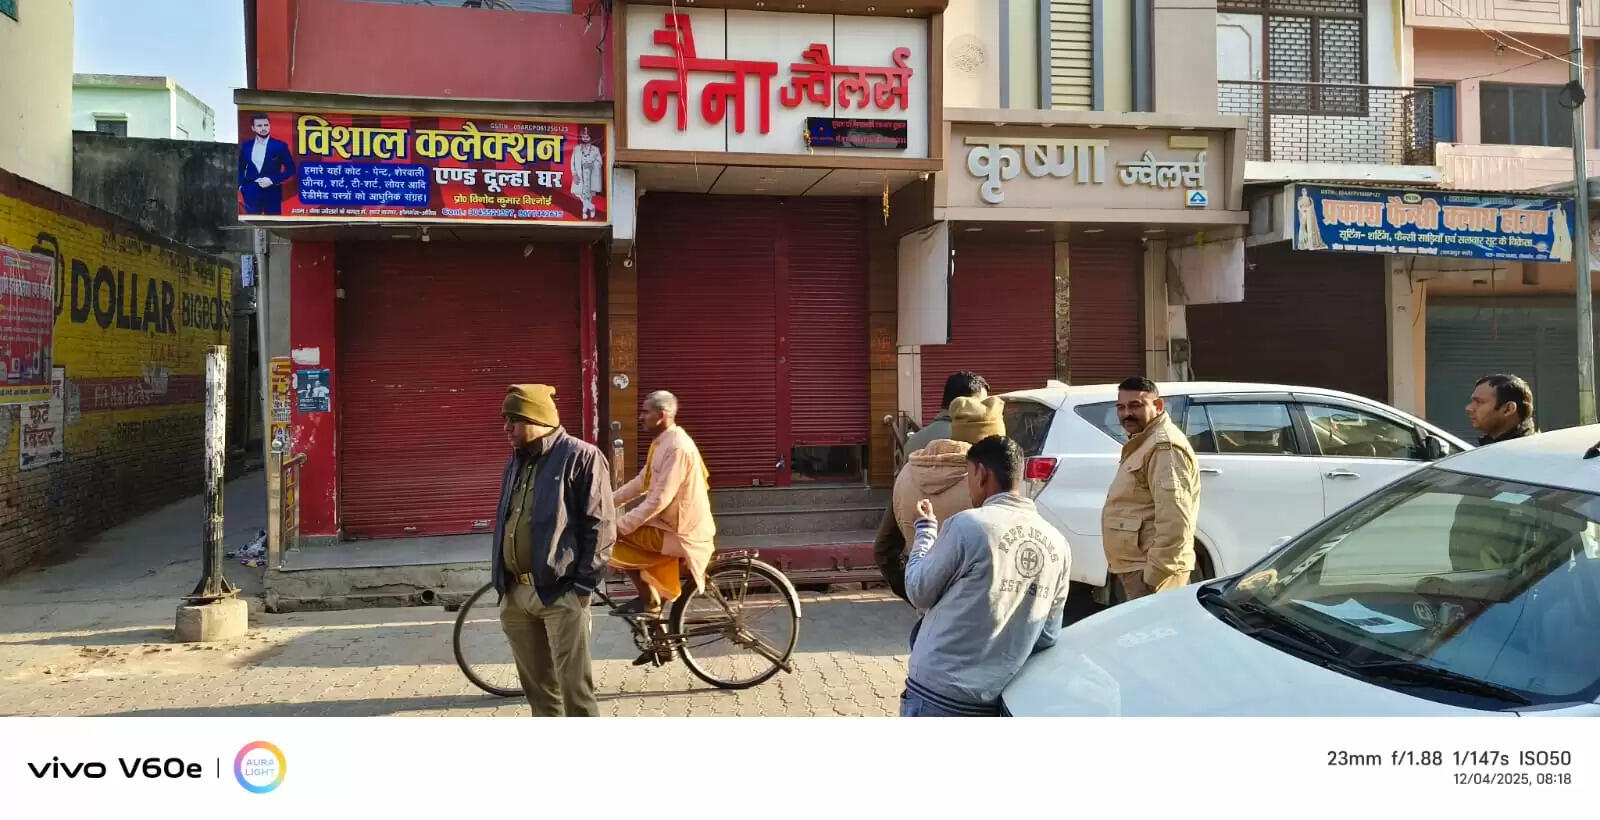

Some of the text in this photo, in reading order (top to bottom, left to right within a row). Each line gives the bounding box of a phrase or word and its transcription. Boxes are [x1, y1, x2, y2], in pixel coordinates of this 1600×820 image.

[640, 13, 914, 134] नैना ज्वैलर्स
[297, 115, 564, 164] विशाल कलैक्शन
[302, 176, 327, 188] जीन्स,
[330, 177, 348, 189] शर्ट,
[407, 178, 427, 189] आदि
[303, 165, 324, 176] हमारे
[326, 165, 341, 175] यहाँ
[344, 166, 361, 175] कोट
[432, 167, 564, 193] एण्ड दूल्हा घर
[965, 136, 1110, 204] कृष्णा
[369, 190, 401, 203] आधुनिक
[497, 195, 521, 207] कुमार
[1321, 198, 1386, 228] प्रकाश
[71, 258, 177, 334] DOLLAR
[998, 525, 1060, 563] PEPE JEANS
[999, 578, 1023, 593] EST
